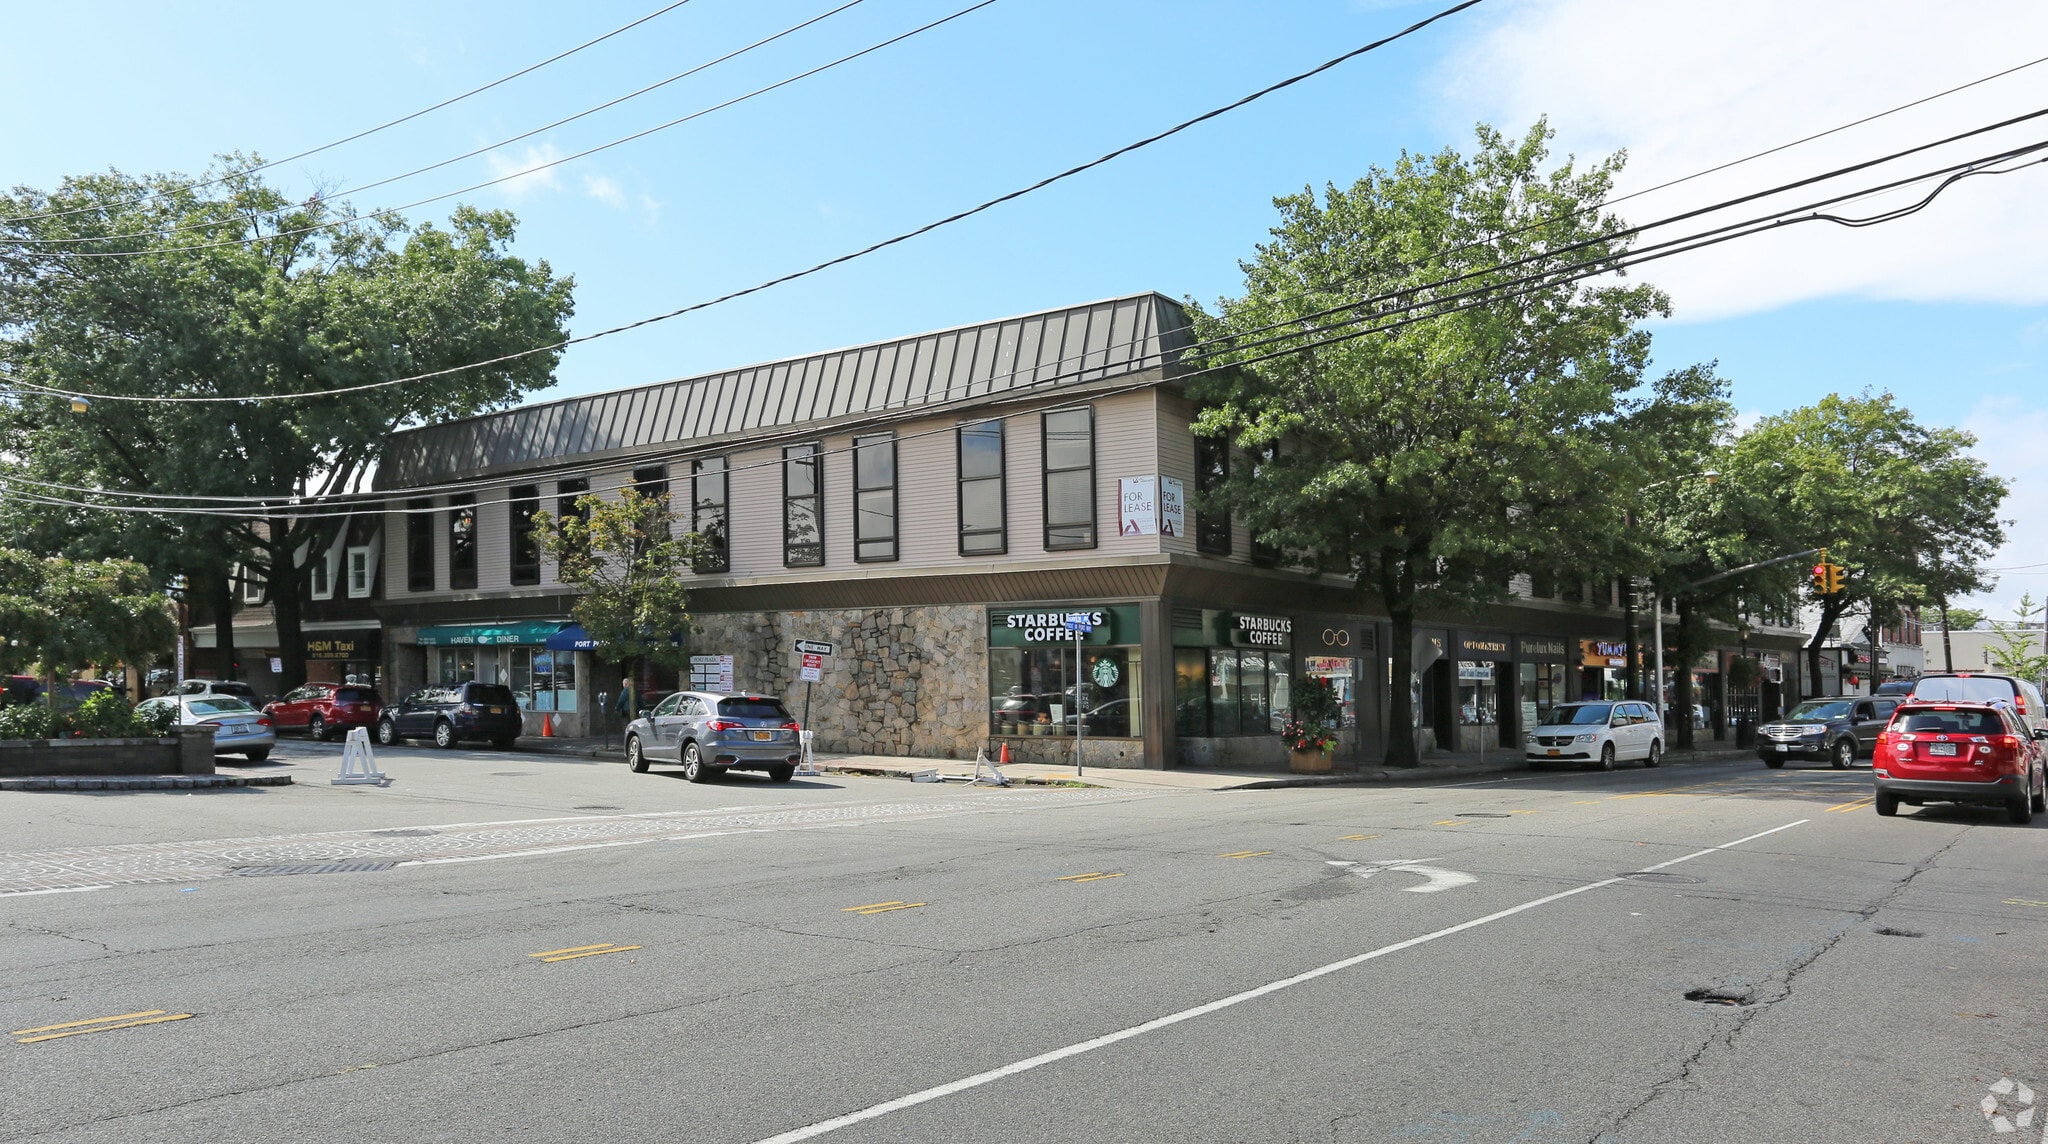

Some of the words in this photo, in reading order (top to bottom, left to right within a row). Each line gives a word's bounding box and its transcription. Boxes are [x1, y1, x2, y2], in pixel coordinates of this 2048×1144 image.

[1124, 492, 1143, 502] FOR
[1163, 491, 1176, 503] FOR
[1124, 502, 1152, 513] LEASE
[1163, 503, 1182, 515] LEASE
[1007, 611, 1102, 628] STARBUS
[1240, 616, 1292, 633] STARBUCKS
[497, 635, 519, 643] DINER
[1250, 631, 1283, 645] COFFEE
[307, 641, 332, 651] H&M
[335, 640, 354, 651] Taxi
[1521, 641, 1548, 654] Purelux
[1548, 642, 1565, 655] Nails
[1597, 642, 1628, 656] YUMMY!
